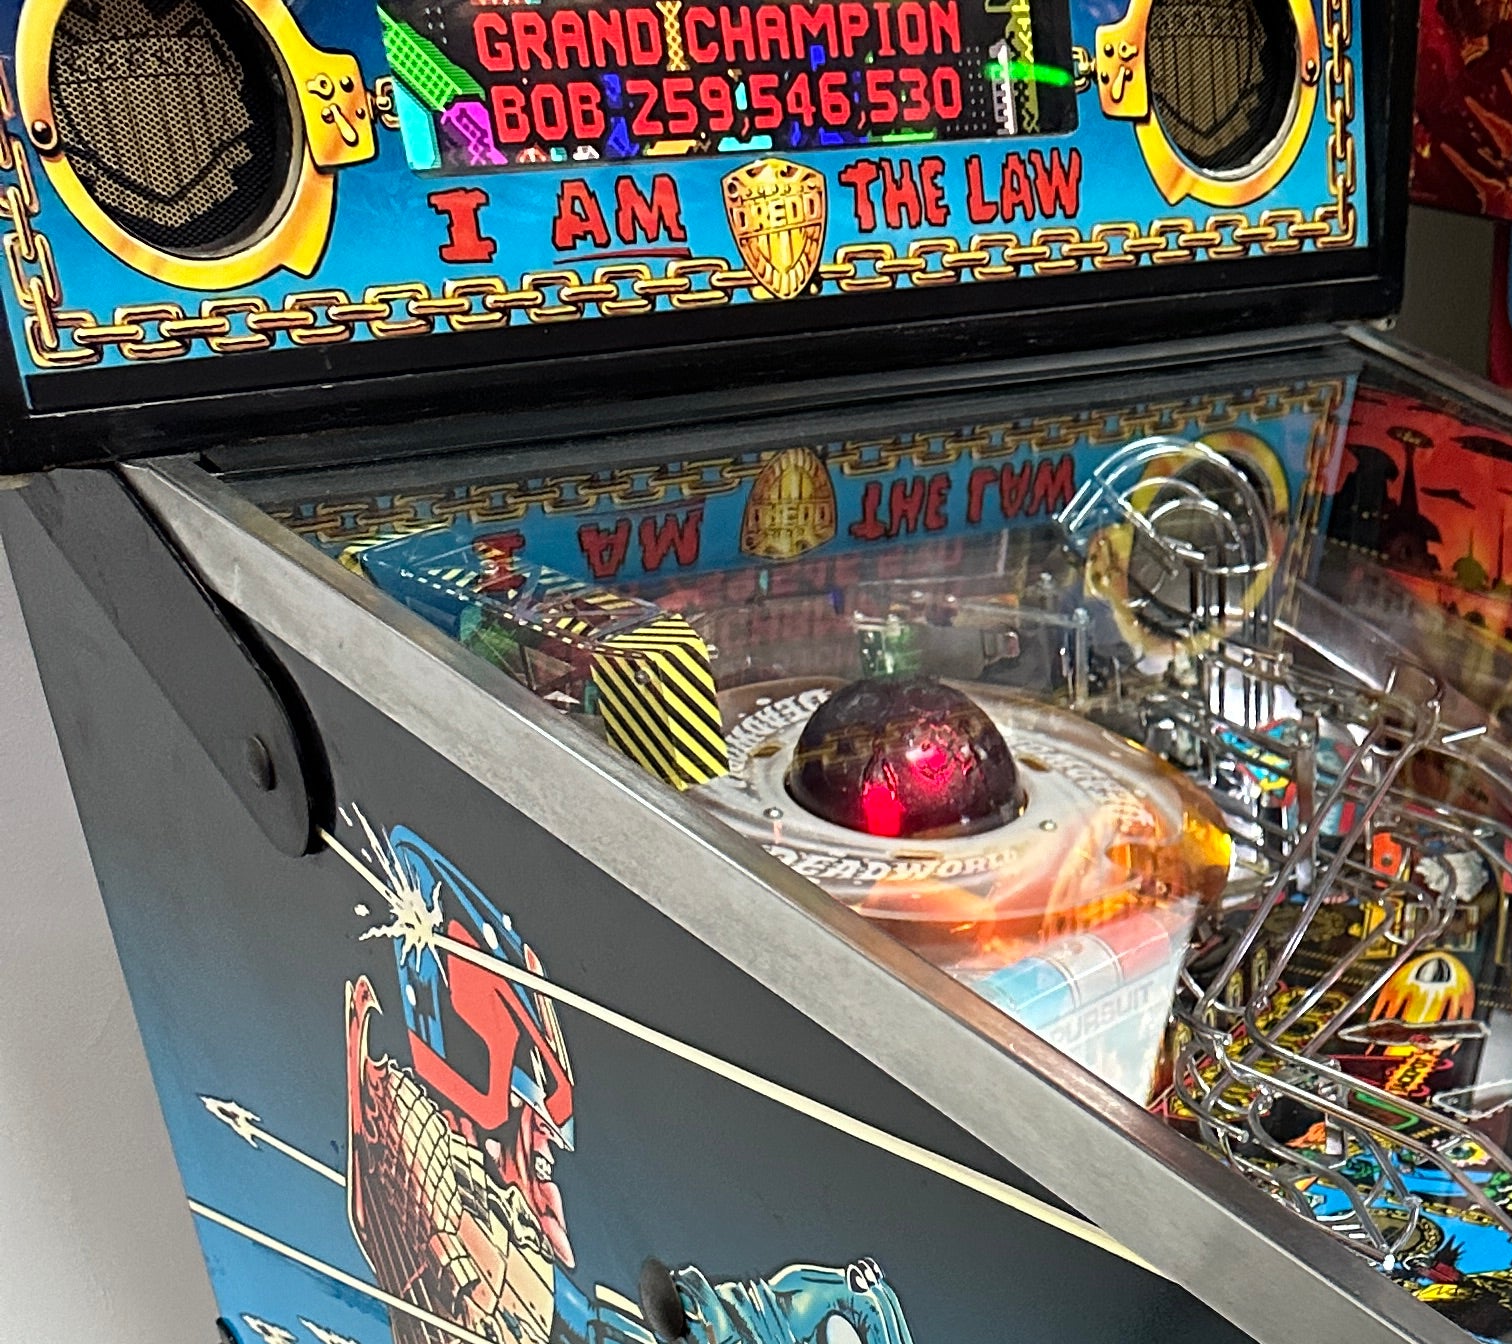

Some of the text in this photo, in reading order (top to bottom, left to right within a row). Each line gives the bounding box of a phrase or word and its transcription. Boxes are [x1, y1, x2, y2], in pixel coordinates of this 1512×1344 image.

[473, 0, 963, 72] GRAND CHAMPION
[490, 66, 963, 144] BOB 259,546,530
[427, 147, 1082, 264] I AM THE LAW
[729, 191, 823, 235] DREDD
[763, 843, 1020, 882] DEADWORLD
